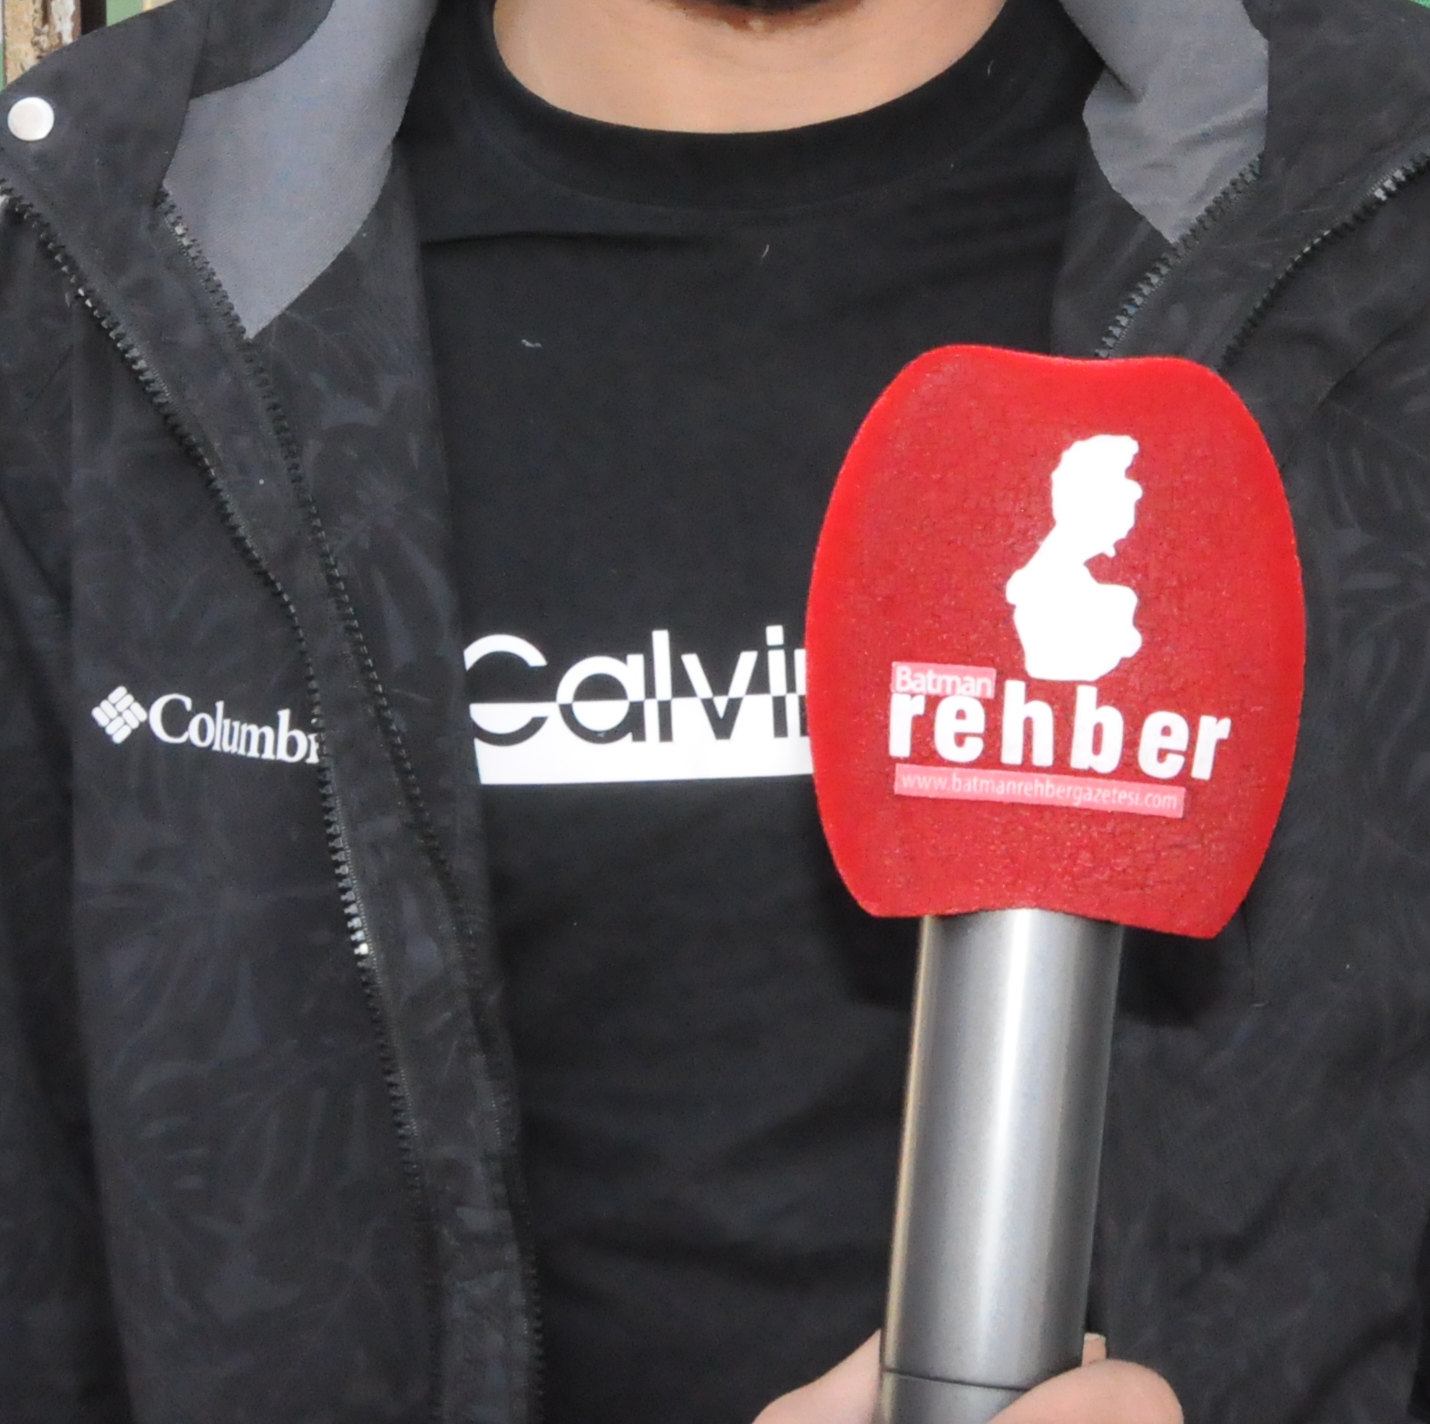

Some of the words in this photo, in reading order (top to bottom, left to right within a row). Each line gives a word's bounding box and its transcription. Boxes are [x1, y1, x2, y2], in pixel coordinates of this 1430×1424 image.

[463, 624, 807, 748] Calvi
[894, 664, 993, 699] Batman
[888, 678, 1231, 782] rehber
[901, 768, 1179, 810] www.batmanrehbergazetesi.com
